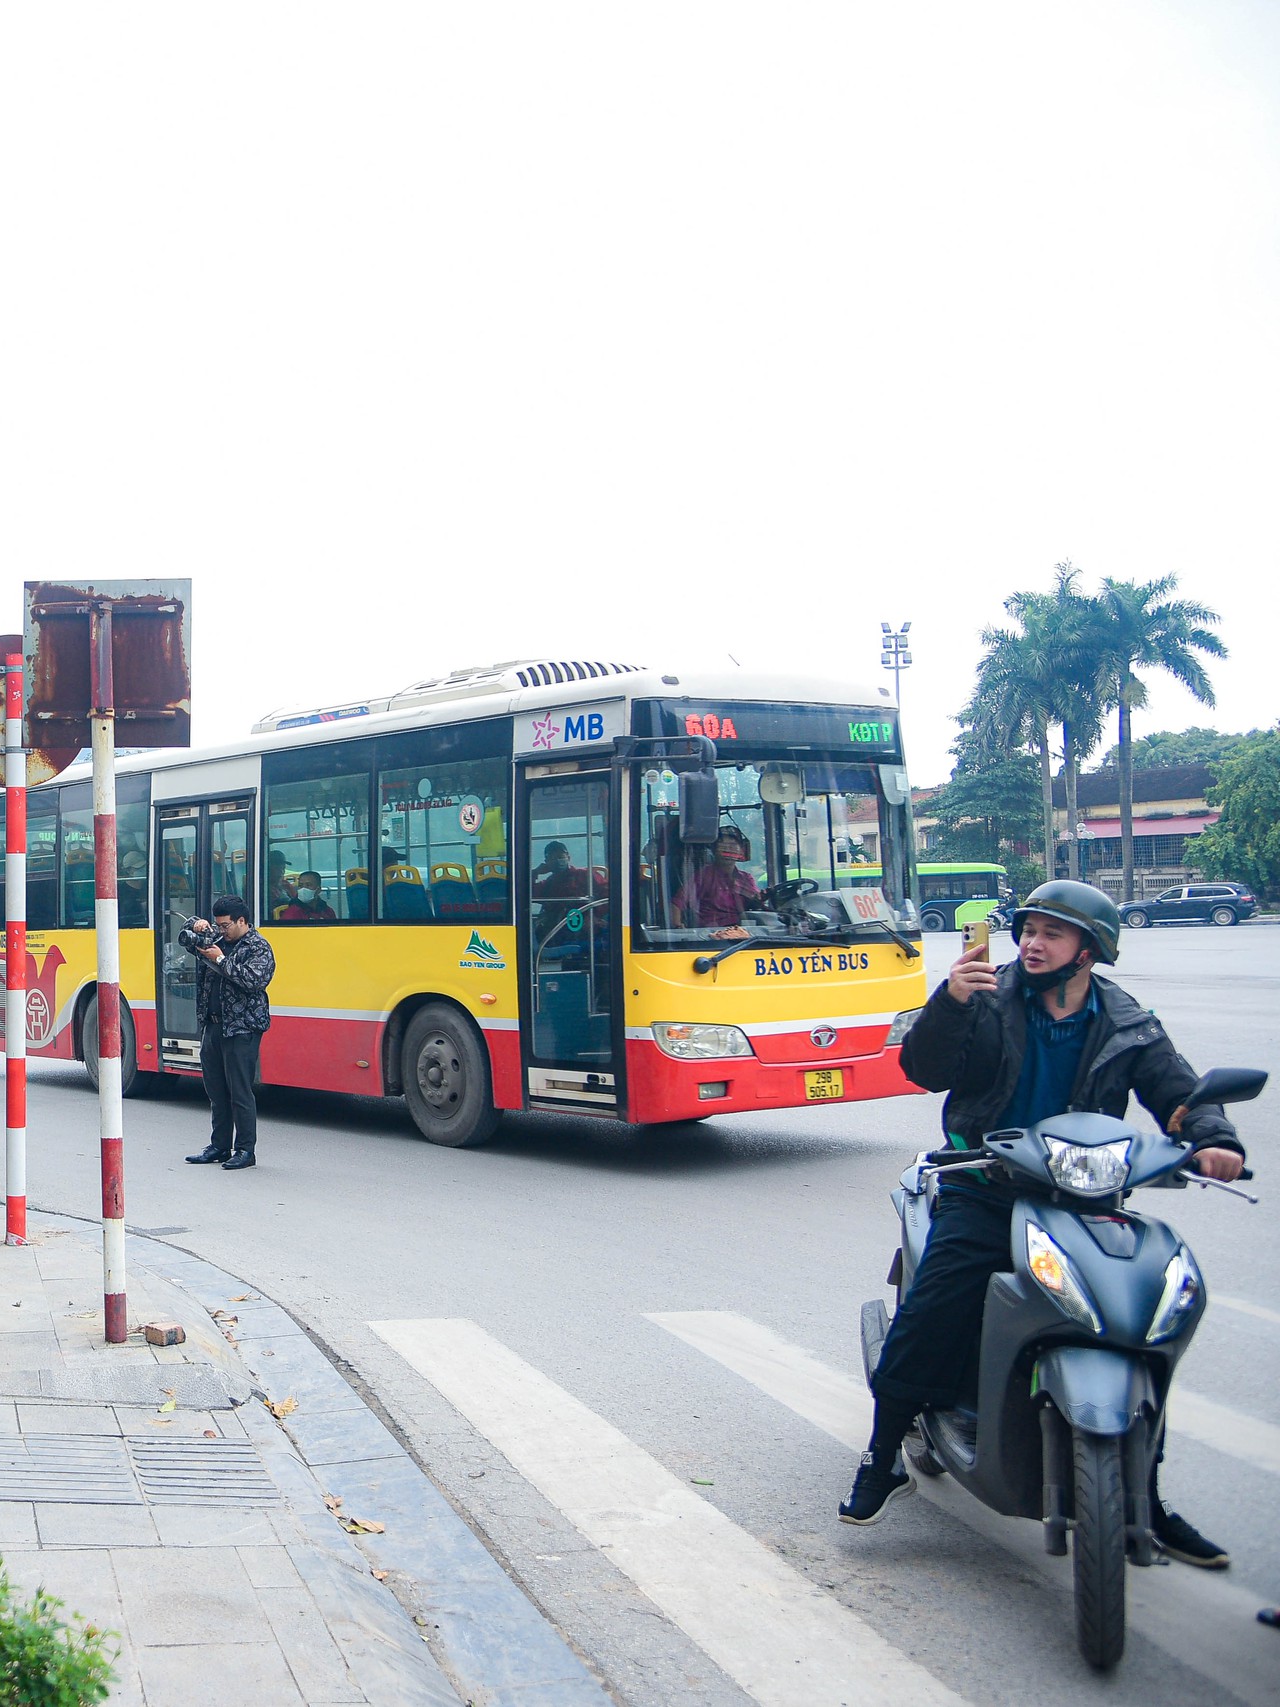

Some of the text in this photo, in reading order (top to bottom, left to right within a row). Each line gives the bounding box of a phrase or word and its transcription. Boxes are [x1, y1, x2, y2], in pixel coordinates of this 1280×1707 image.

[563, 713, 604, 743] MB
[685, 713, 738, 739] 60A
[754, 948, 869, 976] BẢO YẾN BUS
[815, 1071, 833, 1084] 29B
[809, 1084, 840, 1098] 505.17
